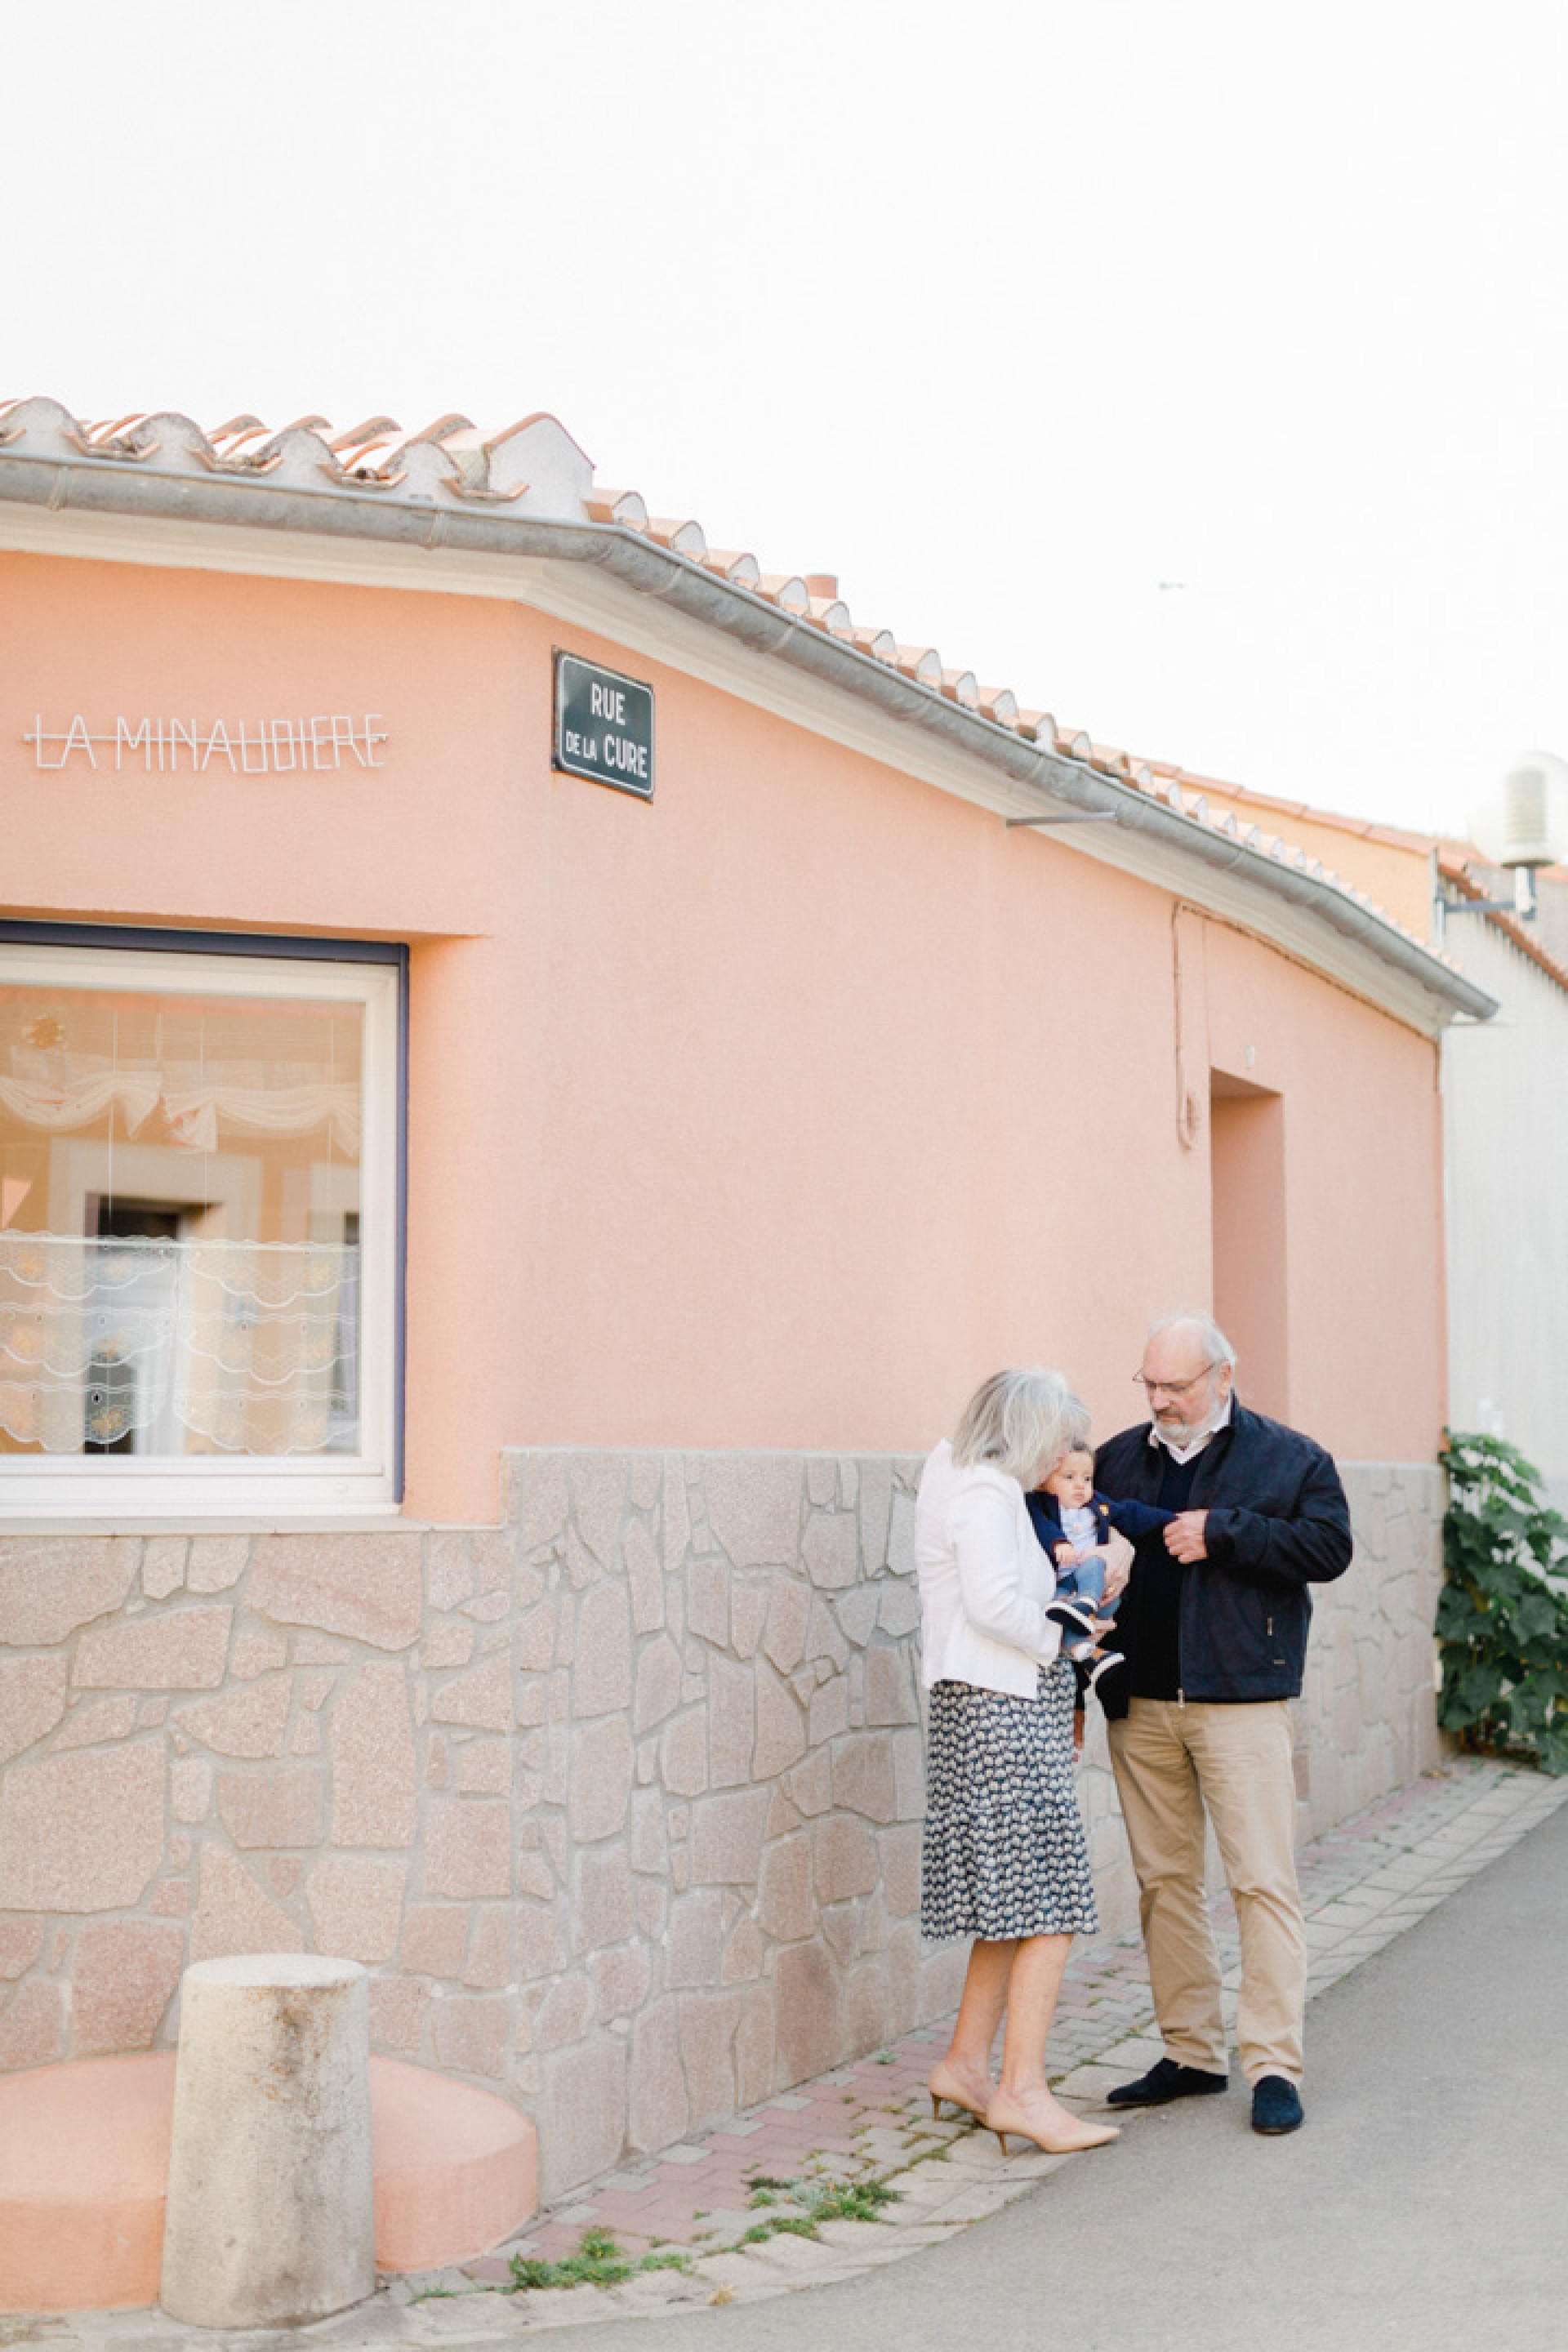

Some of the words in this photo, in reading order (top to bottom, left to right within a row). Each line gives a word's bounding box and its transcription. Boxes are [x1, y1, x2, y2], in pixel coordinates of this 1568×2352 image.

[591, 681, 626, 725] RUE
[35, 714, 97, 768] LA
[115, 714, 385, 772] MINAUDIERE
[565, 729, 581, 755] DE
[583, 736, 598, 761] LA
[604, 734, 648, 778] CURE
